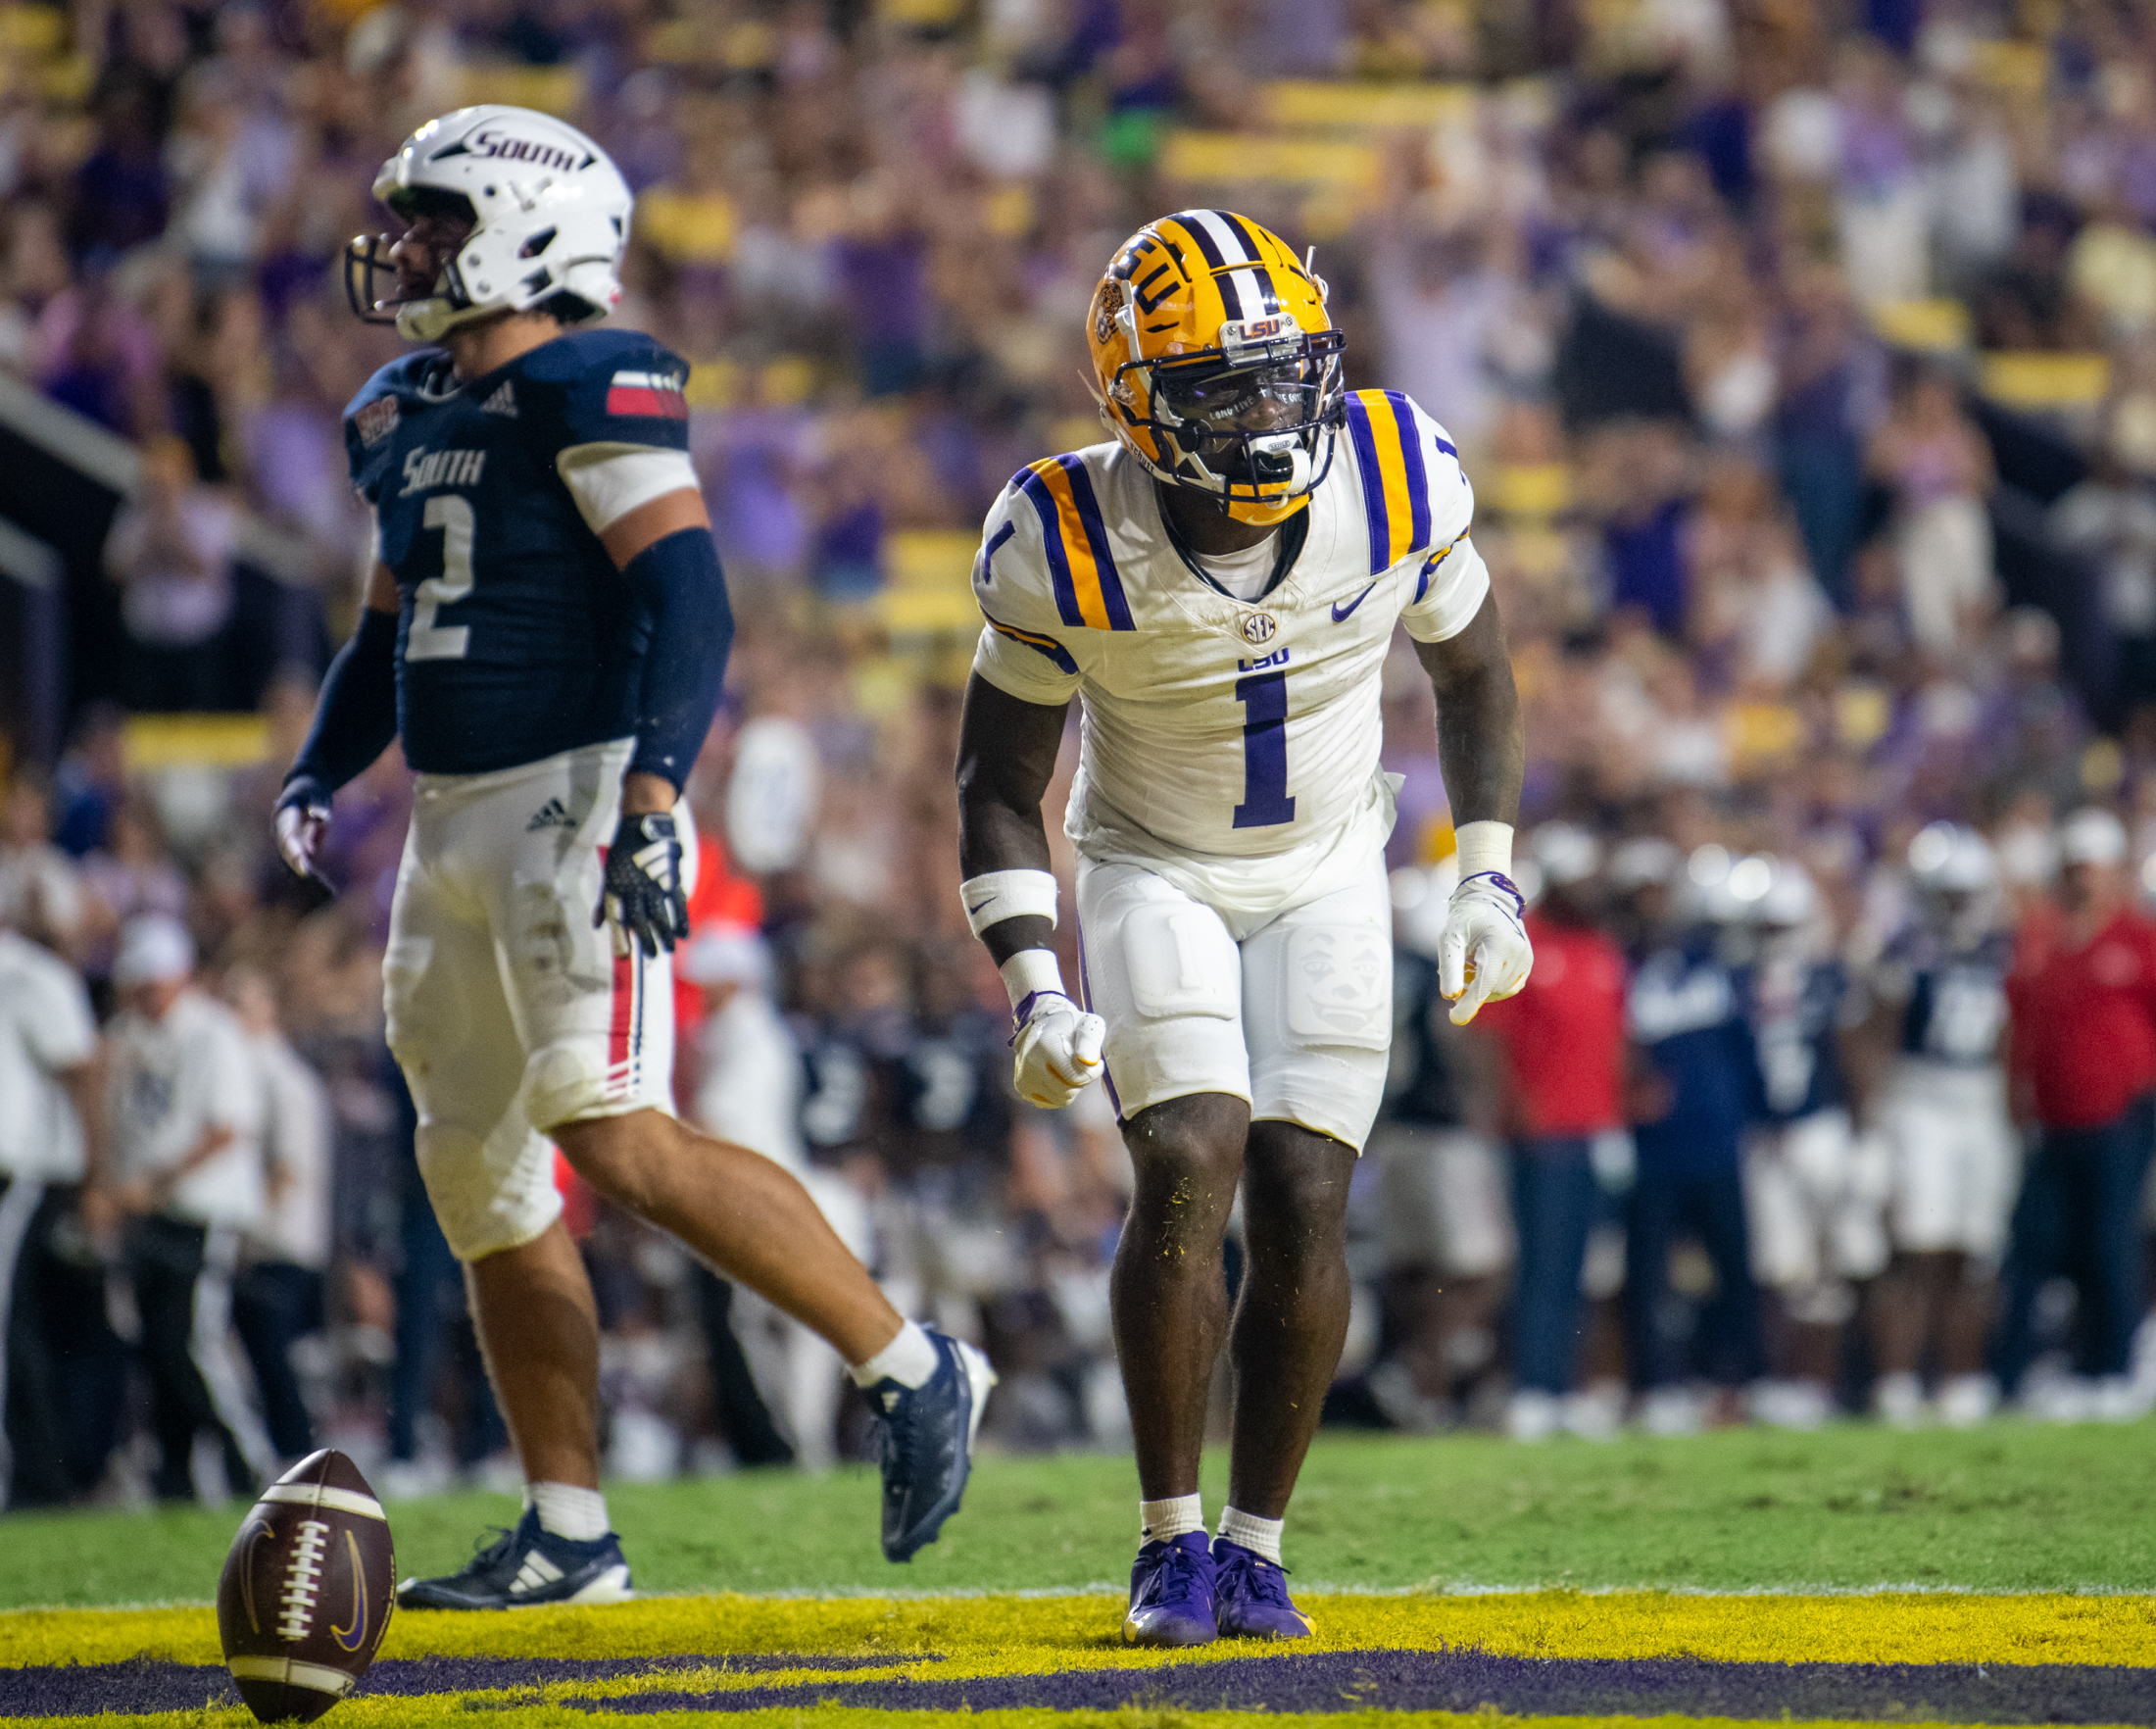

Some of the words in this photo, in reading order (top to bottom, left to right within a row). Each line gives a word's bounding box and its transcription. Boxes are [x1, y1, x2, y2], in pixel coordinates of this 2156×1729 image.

[1239, 319, 1280, 339] LSU
[1129, 442, 1154, 472] schutt
[404, 494, 475, 663] 2
[1244, 614, 1276, 643] SEC
[1237, 647, 1290, 672] LSU
[1232, 670, 1296, 829] 1
